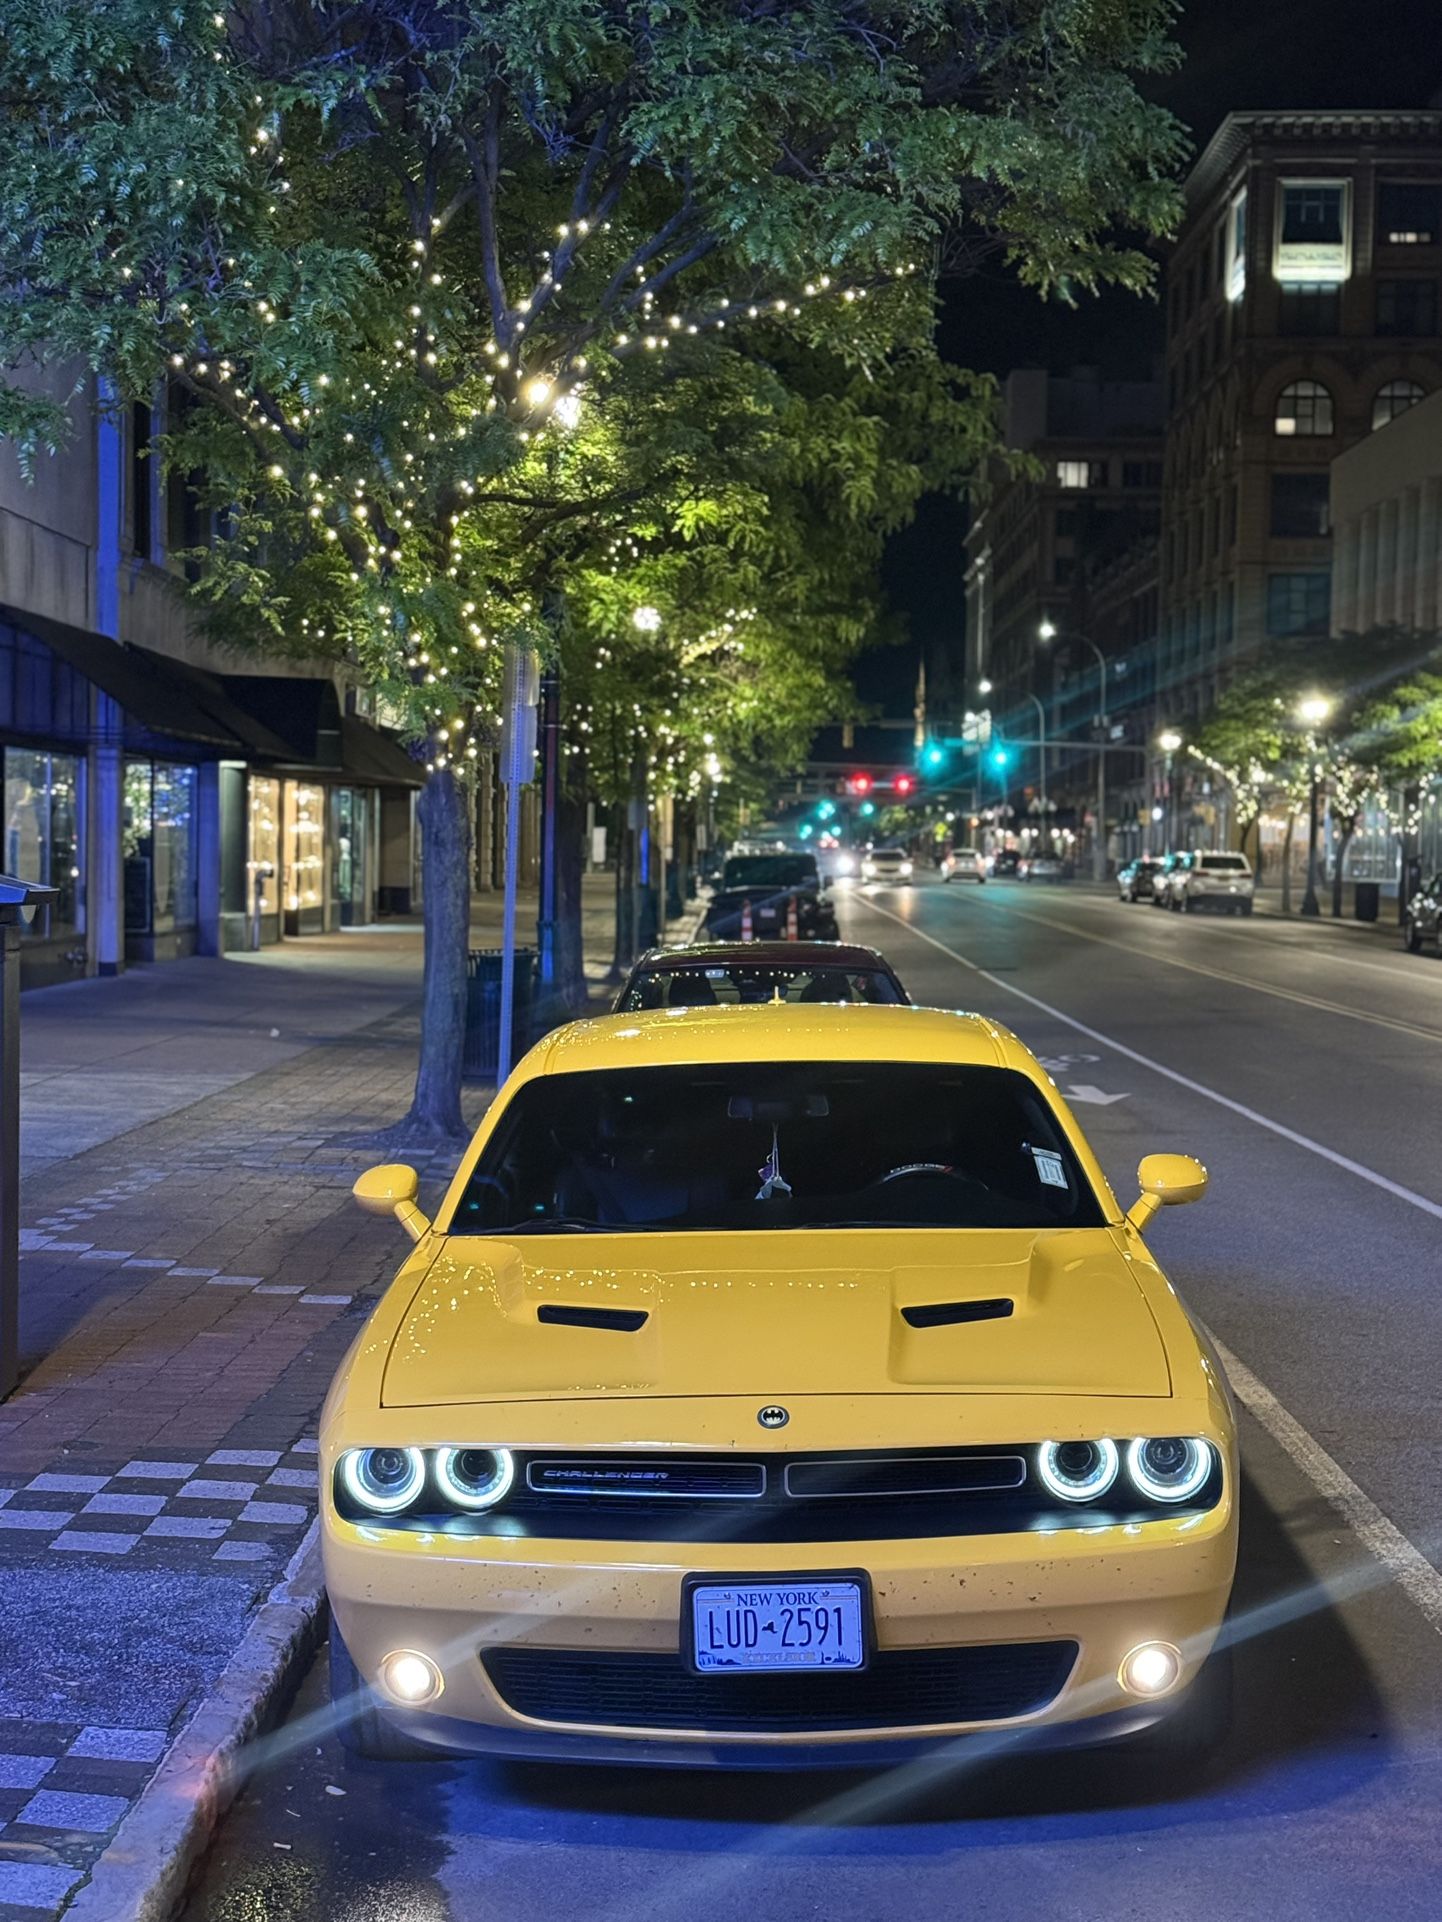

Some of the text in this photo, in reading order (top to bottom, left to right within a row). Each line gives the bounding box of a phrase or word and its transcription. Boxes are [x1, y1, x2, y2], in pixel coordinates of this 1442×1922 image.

[543, 1470, 669, 1479] CHALLENGER
[737, 1591, 819, 1606] NEW YORK
[708, 1606, 843, 1649] LUD 2591
